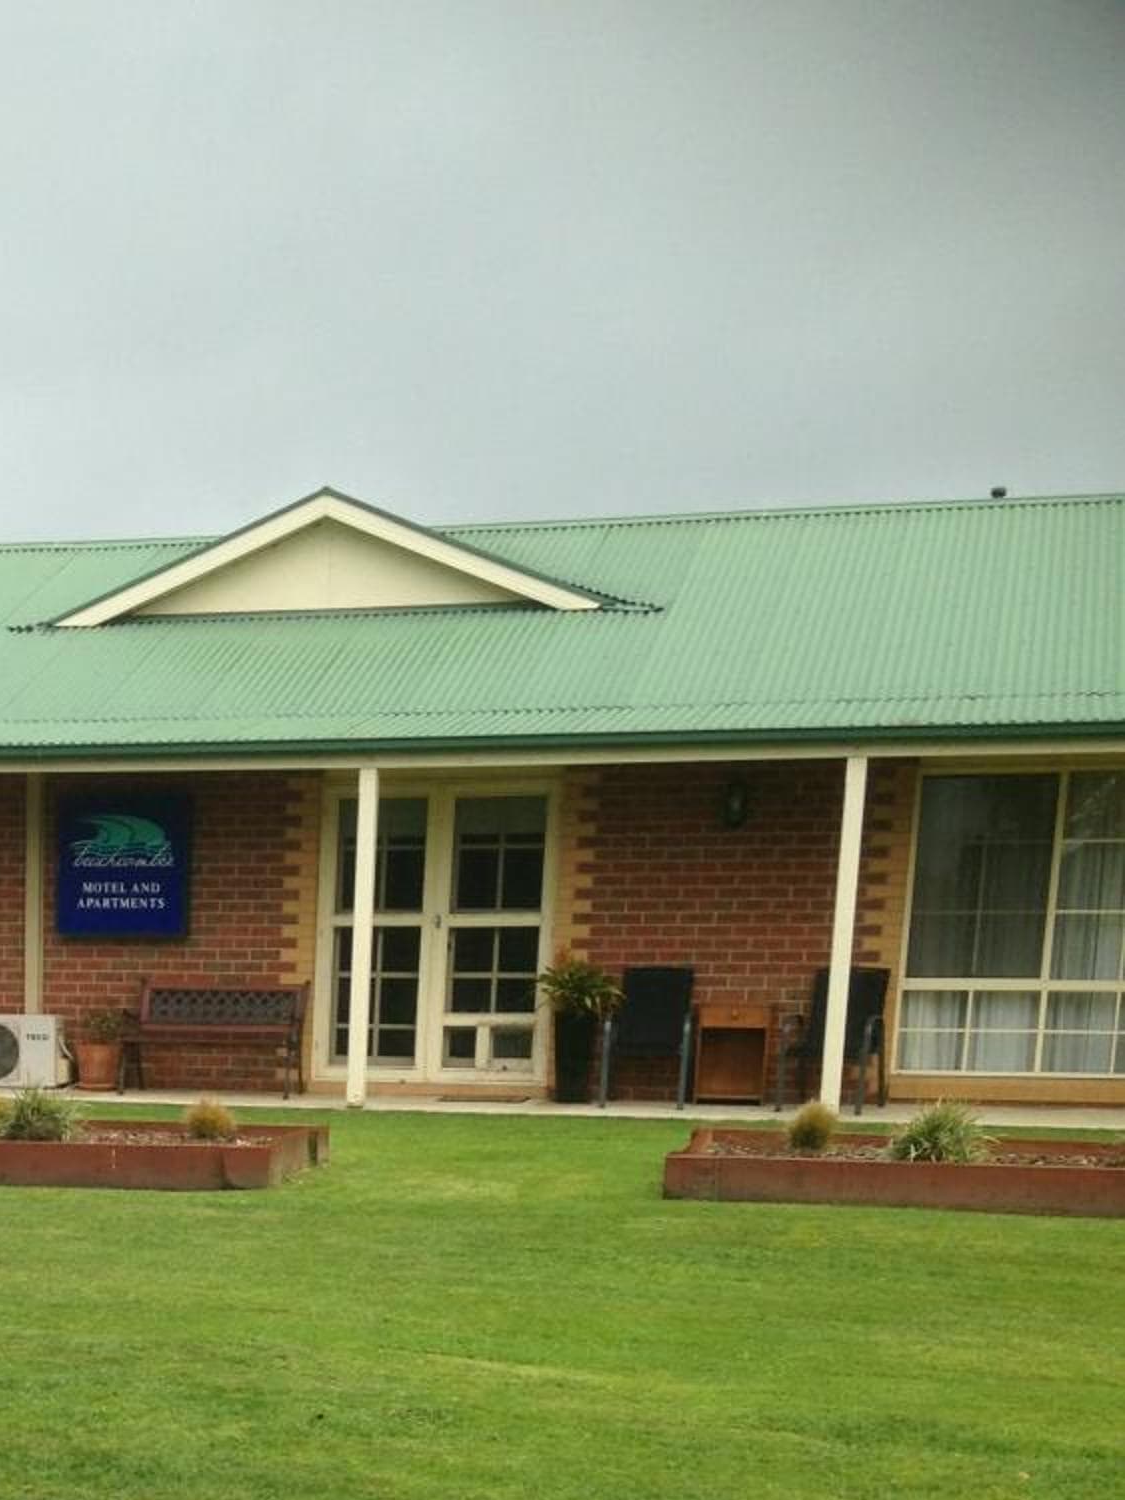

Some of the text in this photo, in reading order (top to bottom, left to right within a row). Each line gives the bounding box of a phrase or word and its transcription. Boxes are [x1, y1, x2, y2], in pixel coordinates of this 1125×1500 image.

[82, 881, 161, 894] MOTEL AND
[76, 896, 166, 909] APARTMENTS
